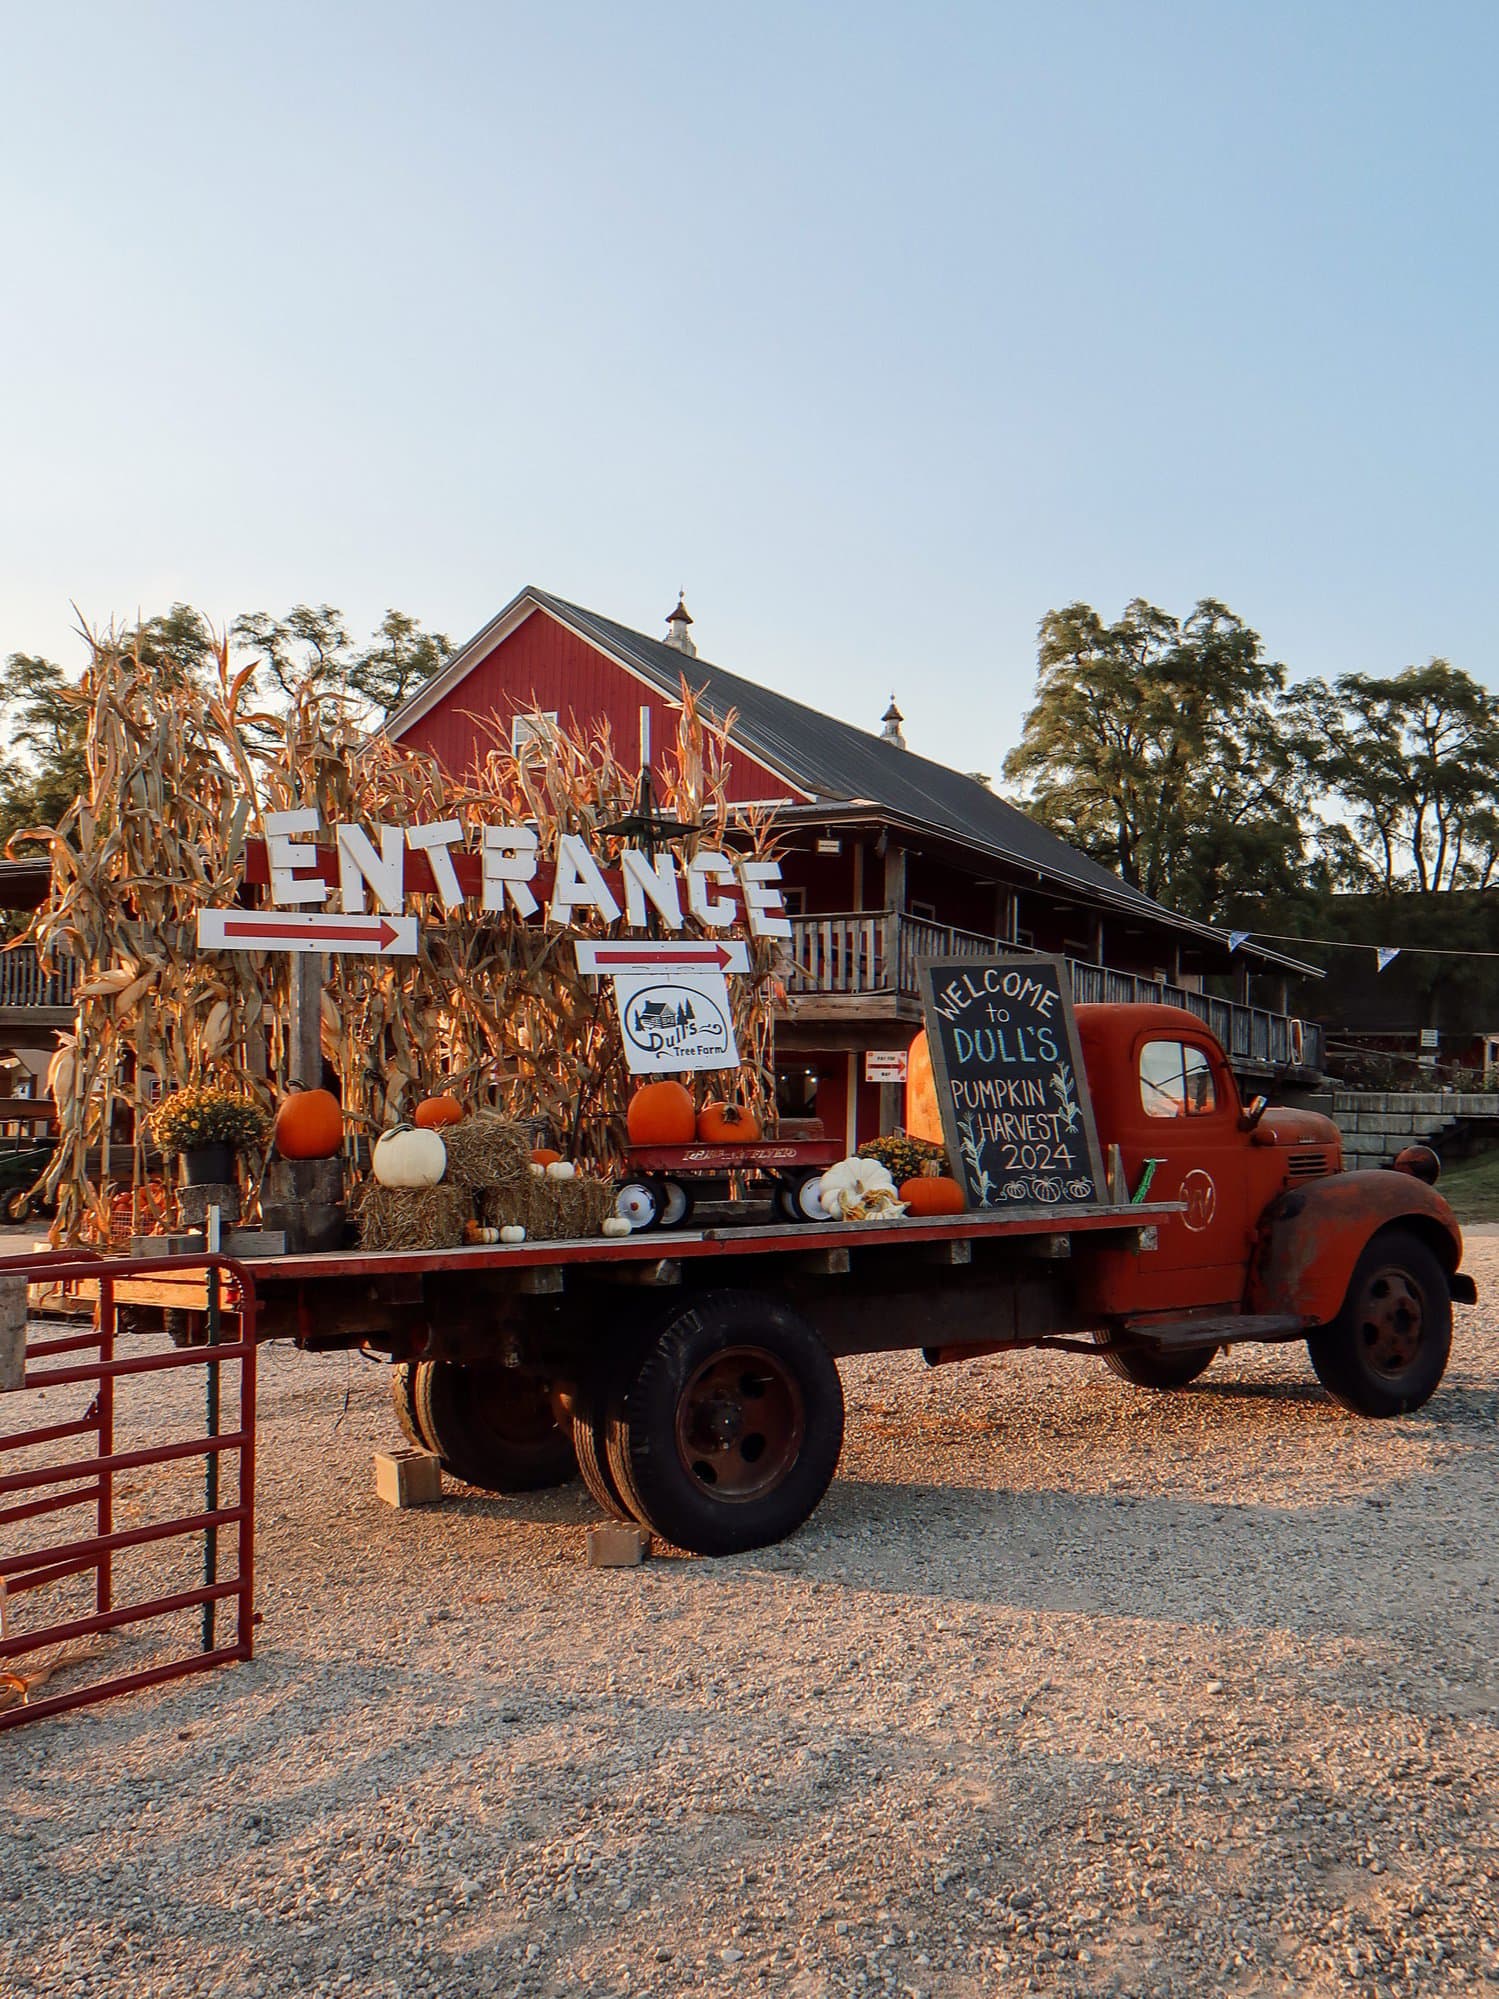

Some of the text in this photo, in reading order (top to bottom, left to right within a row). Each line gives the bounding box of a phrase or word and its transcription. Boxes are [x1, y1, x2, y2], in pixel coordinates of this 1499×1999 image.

[263, 807, 793, 938] ENTRANCE
[933, 969, 1060, 1021] WELCOME
[985, 1002, 1010, 1023] to
[673, 1045, 723, 1057] Tree Farm
[953, 1026, 1059, 1064] DULL'S
[951, 1079, 1047, 1110] PUMPKIN
[977, 1112, 1061, 1143] HARVEST
[1001, 1143, 1078, 1170] 2024
